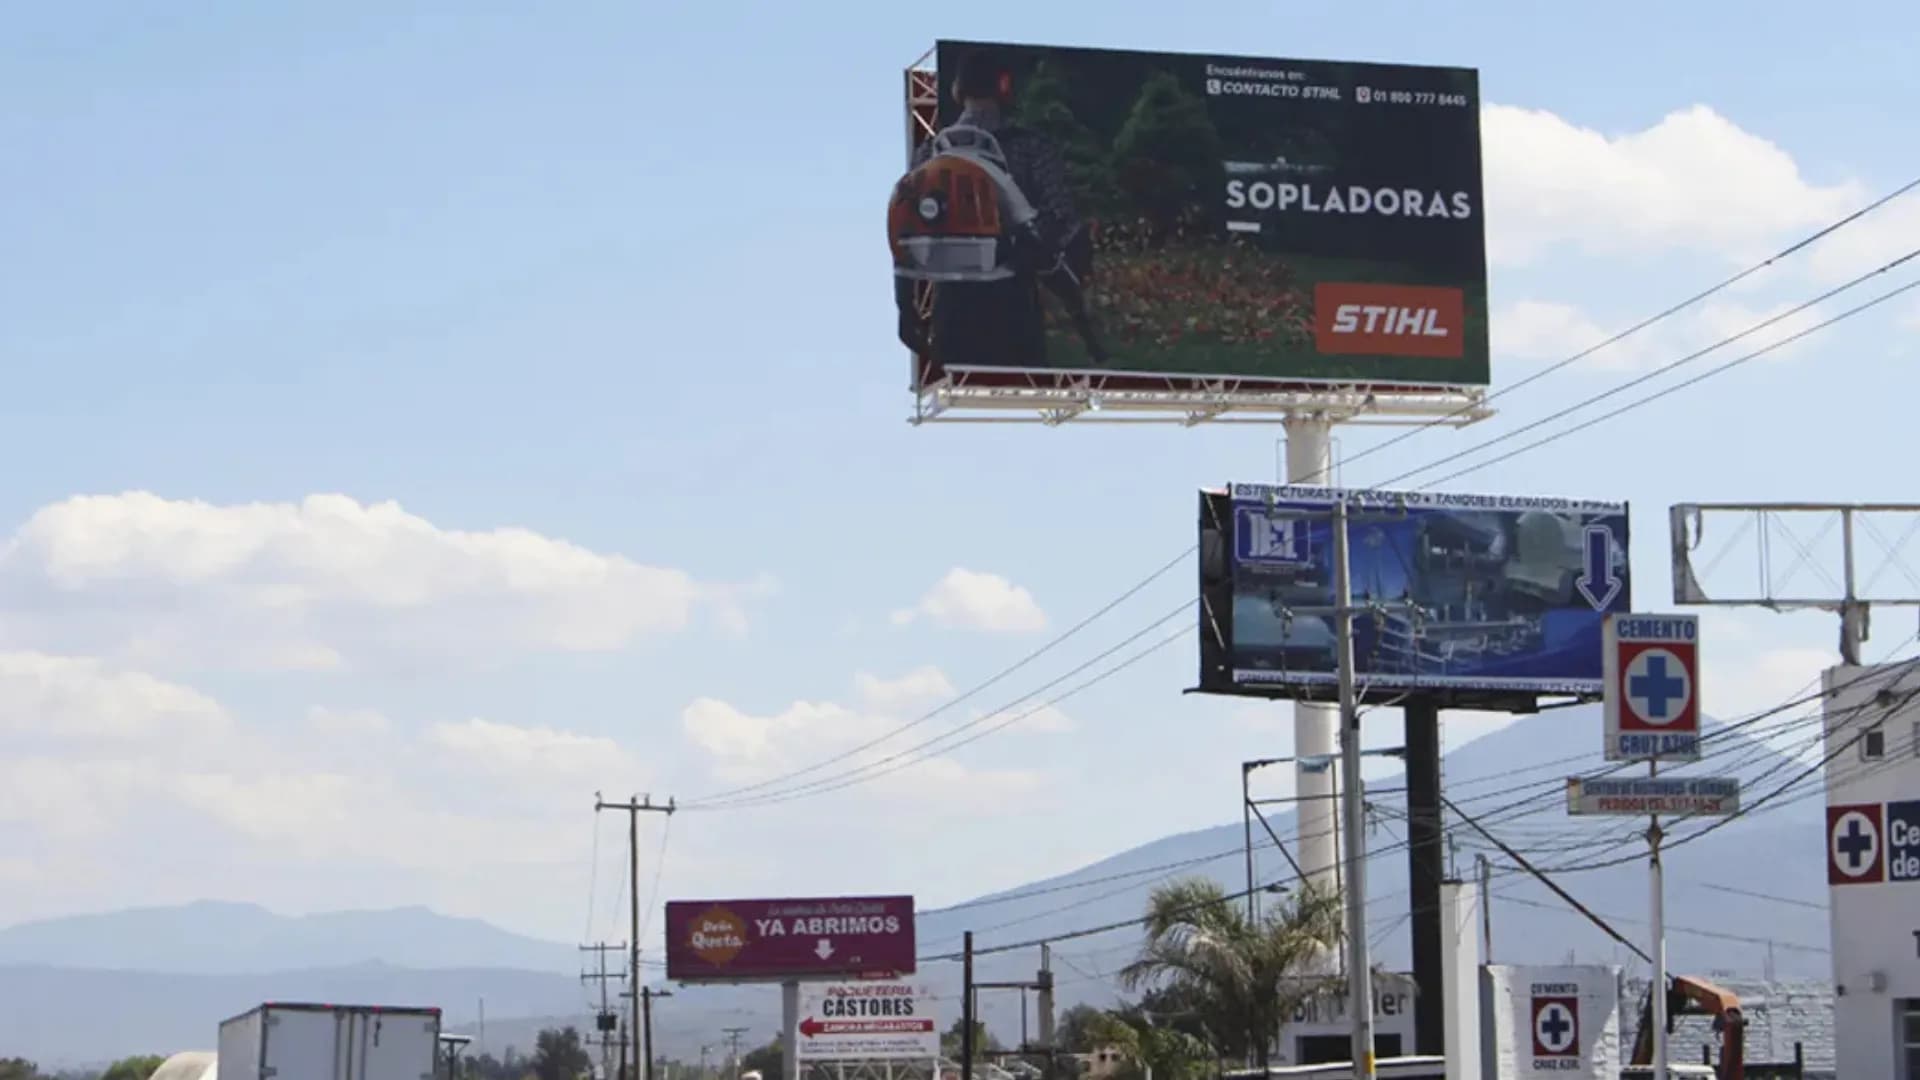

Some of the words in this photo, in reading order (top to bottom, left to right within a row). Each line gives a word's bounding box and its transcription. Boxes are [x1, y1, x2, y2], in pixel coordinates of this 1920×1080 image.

[1223, 81, 1299, 97] CONTACTO
[1302, 86, 1341, 99] STIHL
[1373, 89, 1387, 102] 01
[1415, 92, 1436, 104] 777
[1226, 180, 1472, 218] SOPLADORAS
[1332, 304, 1448, 337] STIHL
[1435, 493, 1493, 507] TANQUES
[1617, 619, 1696, 639] CEMENTO
[1619, 735, 1658, 754] CRUZ
[755, 918, 786, 937] YA
[792, 915, 900, 936] ABRIMOS
[823, 998, 914, 1017] CASTORES
